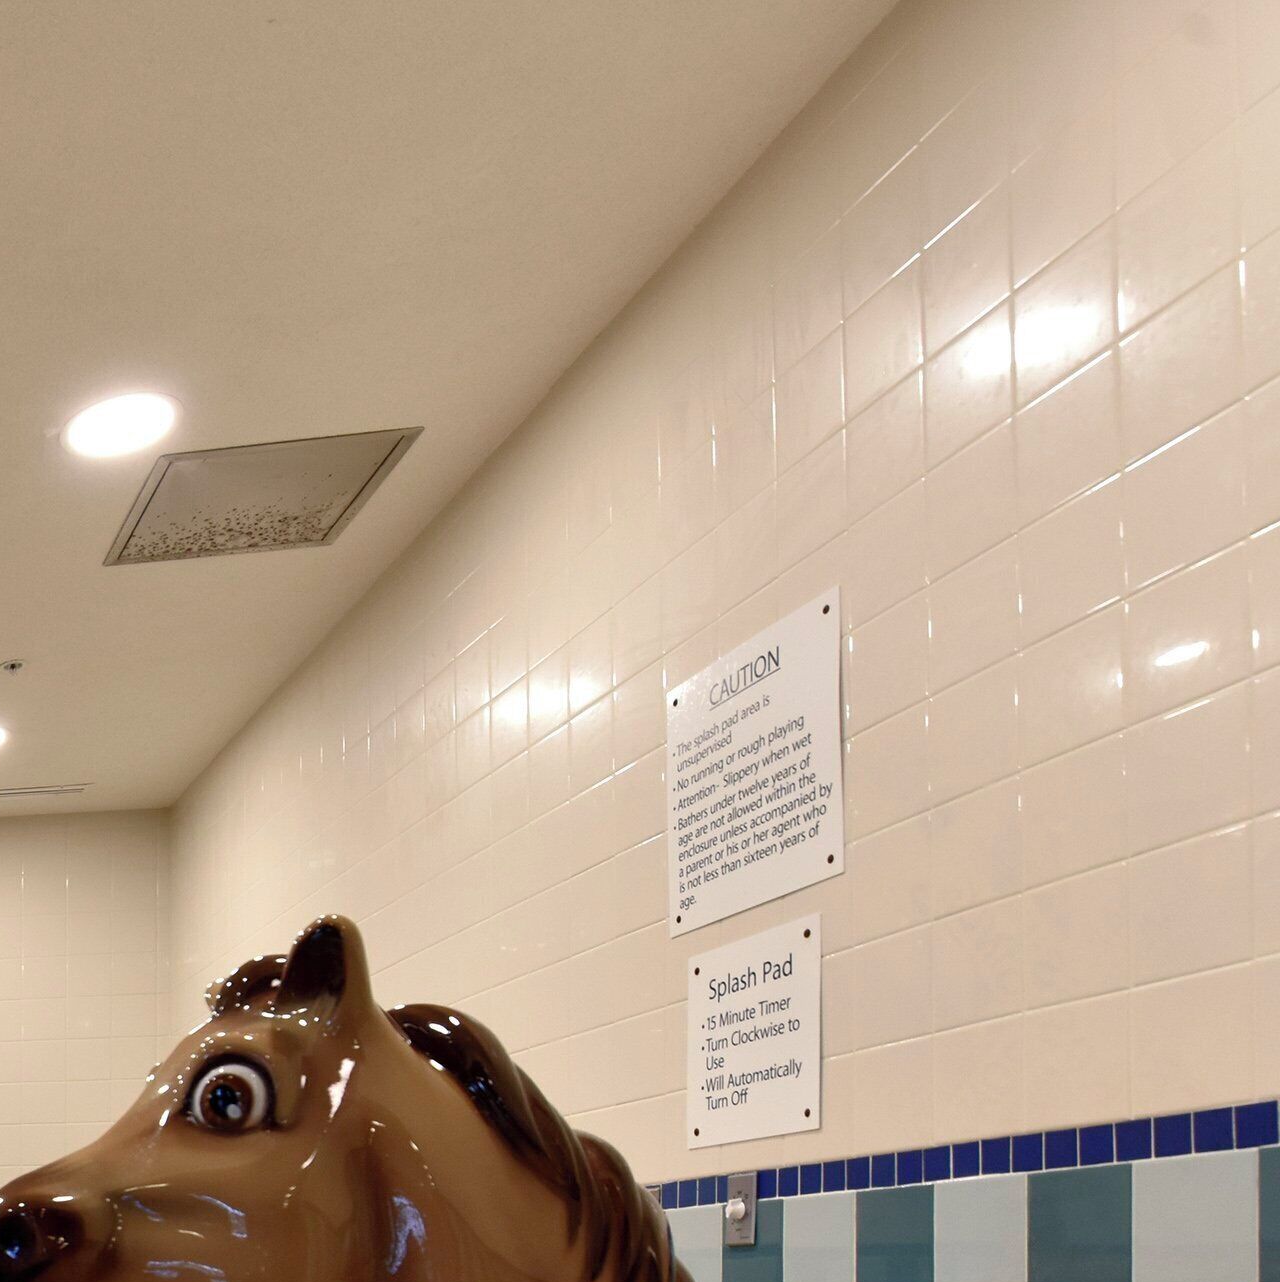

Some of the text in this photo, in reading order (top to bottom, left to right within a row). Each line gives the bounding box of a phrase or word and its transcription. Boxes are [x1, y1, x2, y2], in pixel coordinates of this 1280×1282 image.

[709, 645, 780, 705] CAUTION
[676, 694, 770, 757] The splash pad area is
[677, 730, 732, 773] unsupervised
[677, 715, 805, 792] No running or rough playing
[722, 760, 760, 788] Slippery
[761, 745, 790, 767] when
[791, 732, 812, 752] wet
[677, 752, 811, 831] Bathers under twelve years of
[678, 772, 816, 848] age are not allowed within the
[678, 782, 833, 862] enclosure unless accompanied by
[678, 804, 827, 878] a parent or his or her agent who
[679, 820, 820, 894] is not less than sixteen years of
[679, 895, 697, 911] age.
[709, 953, 793, 1003] Splash Pad
[706, 1018, 800, 1053] Turn Clockwise to
[707, 997, 791, 1031] 15 Minute Timer
[706, 1055, 725, 1071] Use
[706, 1058, 802, 1093] Will Automatically
[706, 1087, 749, 1111] Turn Off
